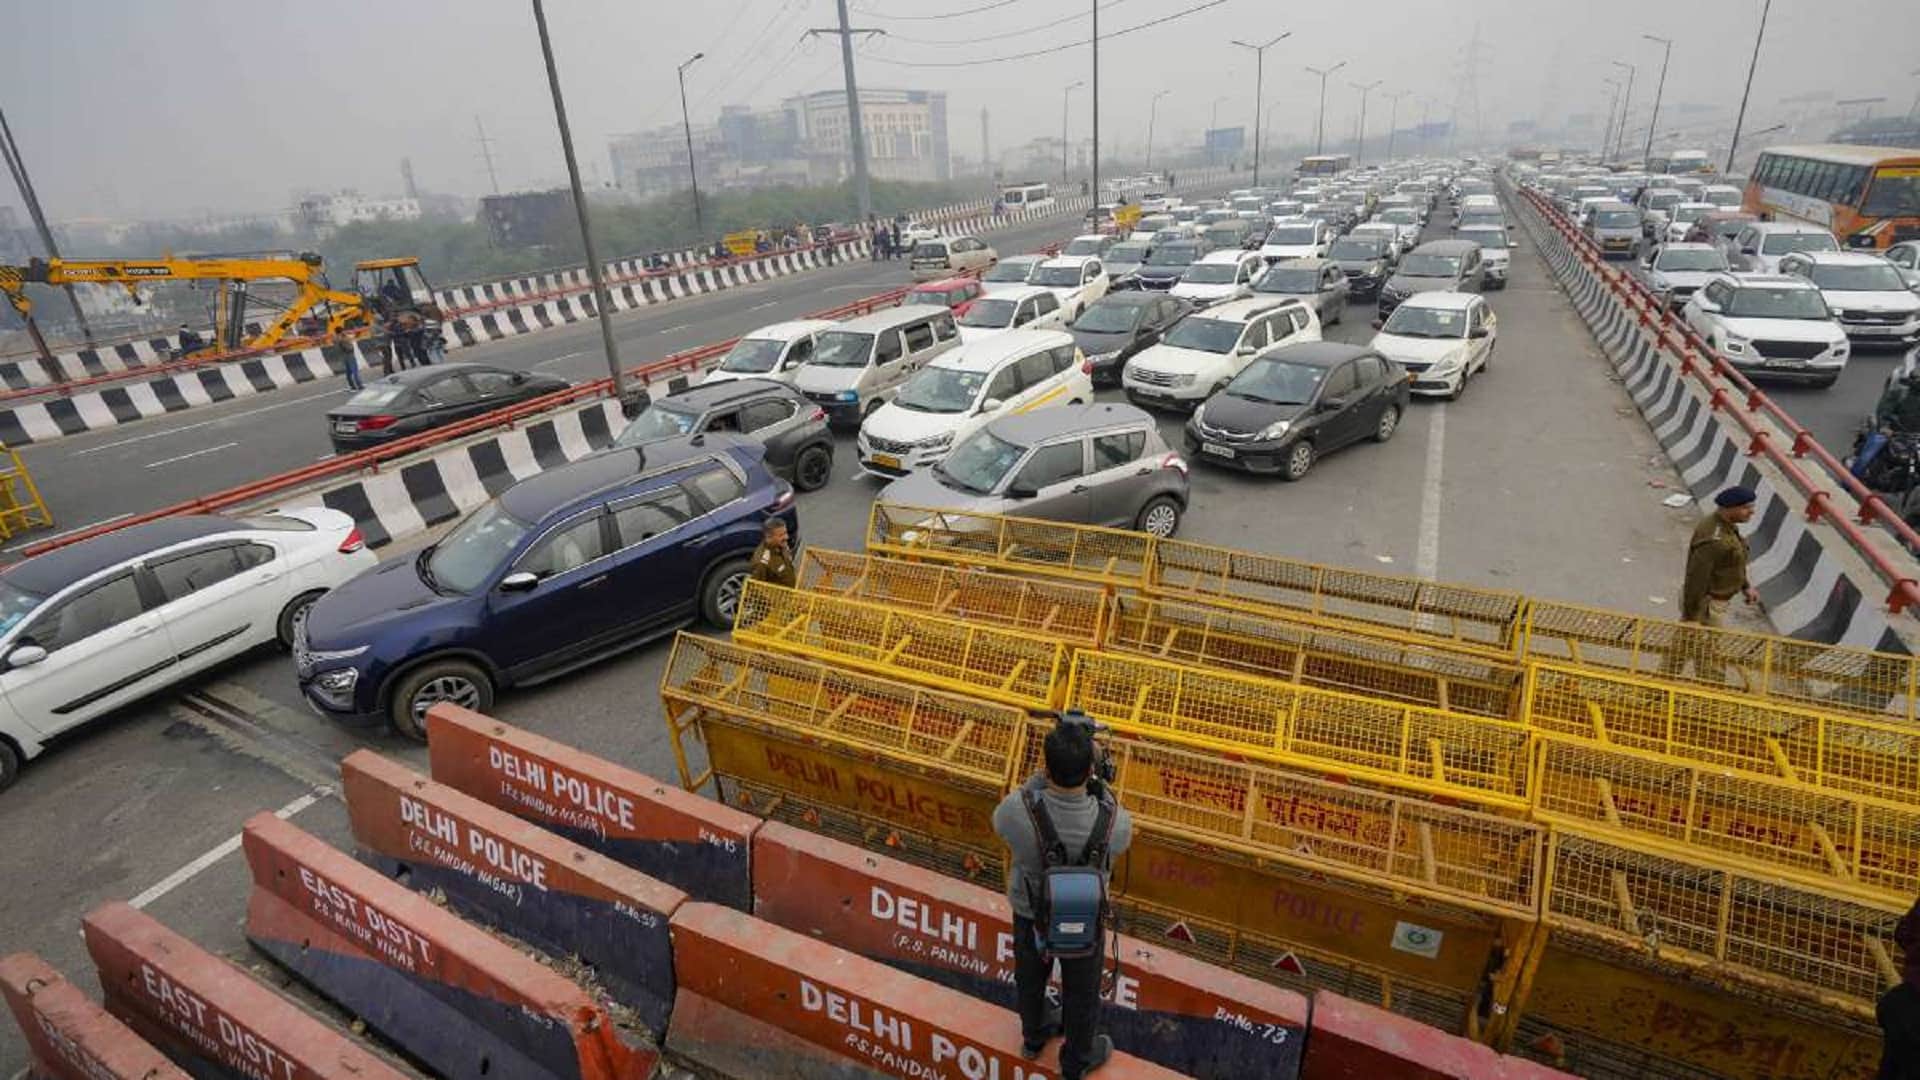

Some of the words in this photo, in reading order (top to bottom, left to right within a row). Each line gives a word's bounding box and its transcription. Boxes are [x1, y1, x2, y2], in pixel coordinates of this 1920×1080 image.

[489, 746, 548, 792] DELHI
[552, 770, 636, 831] POLICE
[765, 744, 841, 793] DELHI
[855, 772, 961, 828] POLICE
[400, 795, 459, 847] DELHI
[469, 831, 549, 892] POLICE
[300, 867, 358, 918] EAST
[364, 902, 436, 966] DISTT.
[477, 869, 523, 908] NAGAR)
[870, 885, 978, 951] DELHI
[376, 936, 418, 972] VIHAR
[930, 945, 990, 975] PANDAV
[141, 964, 208, 1028] EAST
[217, 1013, 299, 1080] DISTT
[800, 979, 914, 1051] DELHI
